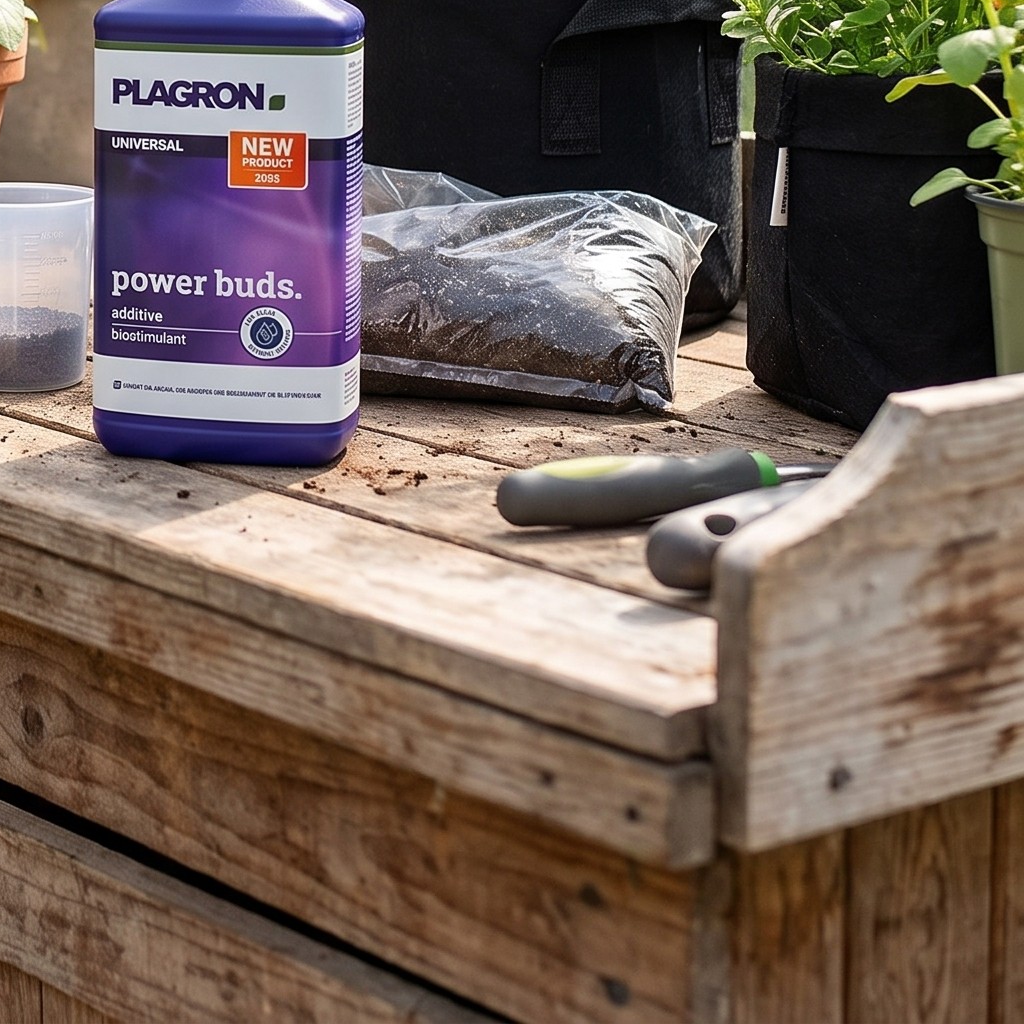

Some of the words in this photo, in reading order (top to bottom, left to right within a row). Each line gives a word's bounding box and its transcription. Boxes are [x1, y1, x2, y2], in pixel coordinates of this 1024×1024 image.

[112, 78, 265, 111] PLAGRON
[111, 136, 184, 152] UNIVERSAL
[242, 137, 293, 157] NEW
[242, 158, 293, 169] PRODUCT
[111, 270, 208, 297] power
[214, 269, 302, 300] buds.
[111, 306, 163, 323] additive
[111, 328, 187, 346] biostimulant
